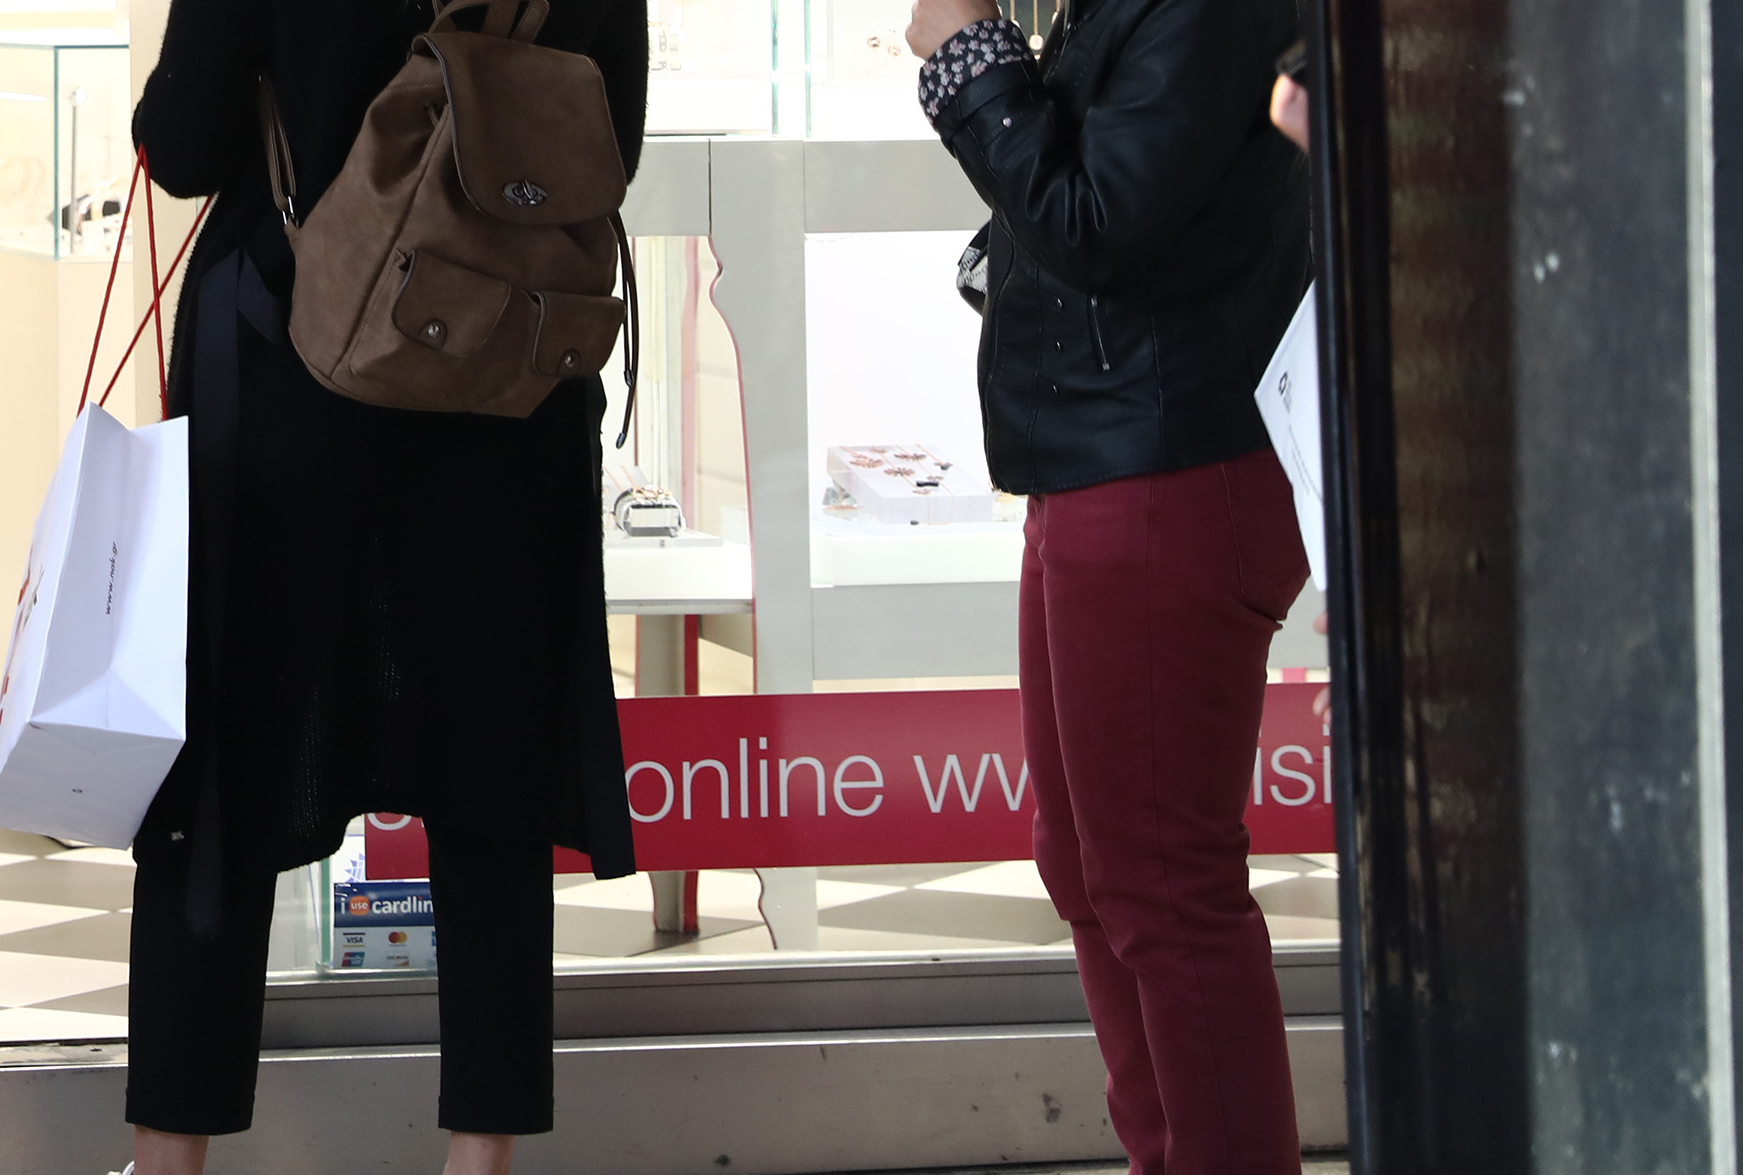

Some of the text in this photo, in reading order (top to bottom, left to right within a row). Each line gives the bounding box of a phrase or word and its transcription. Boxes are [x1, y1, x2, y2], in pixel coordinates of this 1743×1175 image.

[625, 736, 885, 823] online
[350, 900, 369, 910] use
[372, 895, 434, 914] cardlin
[345, 936, 364, 944] VISA
